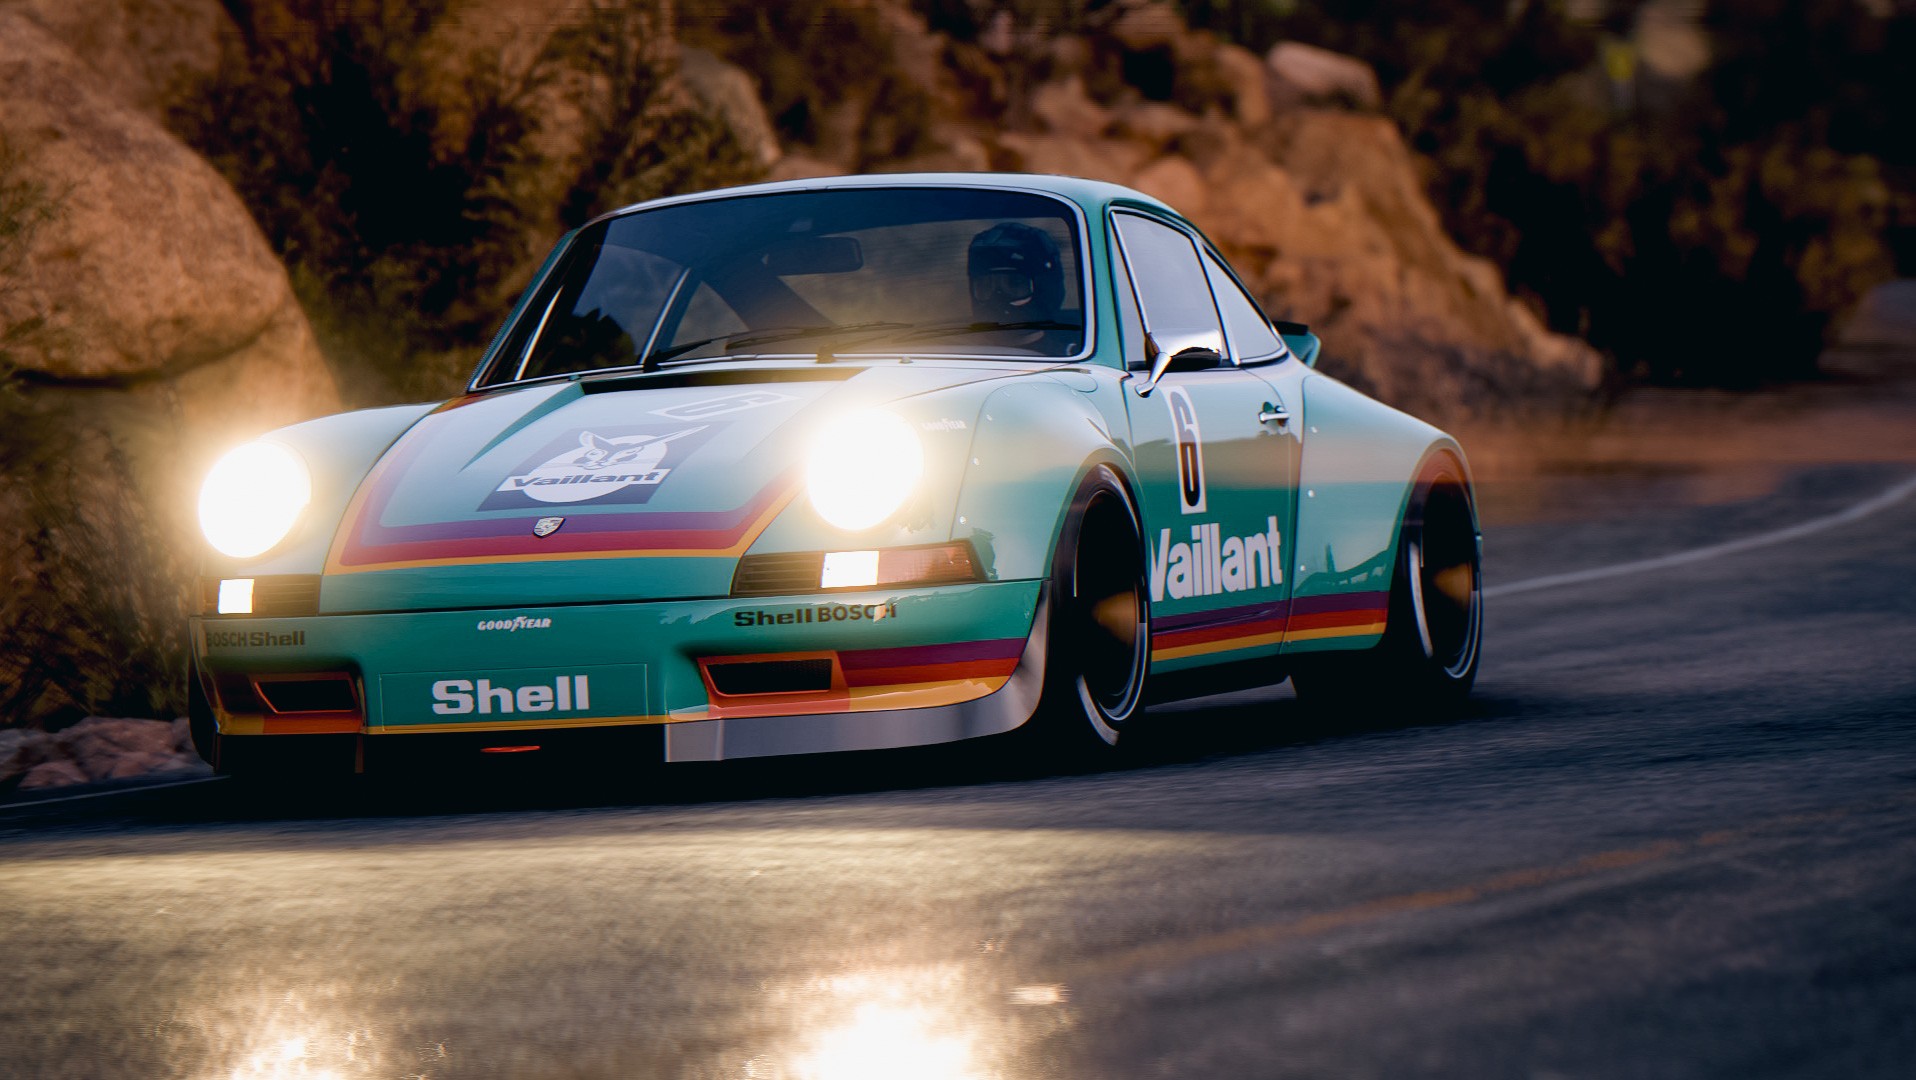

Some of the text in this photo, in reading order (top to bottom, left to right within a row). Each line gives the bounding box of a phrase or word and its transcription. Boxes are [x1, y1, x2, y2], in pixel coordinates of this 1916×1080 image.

[1170, 390, 1201, 506] 6
[514, 471, 660, 487] Vaillant
[1150, 516, 1282, 602] Vaillant
[477, 616, 553, 632] GOODYEAR
[734, 603, 897, 627] Shell BOSCH
[206, 630, 305, 647] BOSCH Shell
[432, 675, 590, 715] Shell
